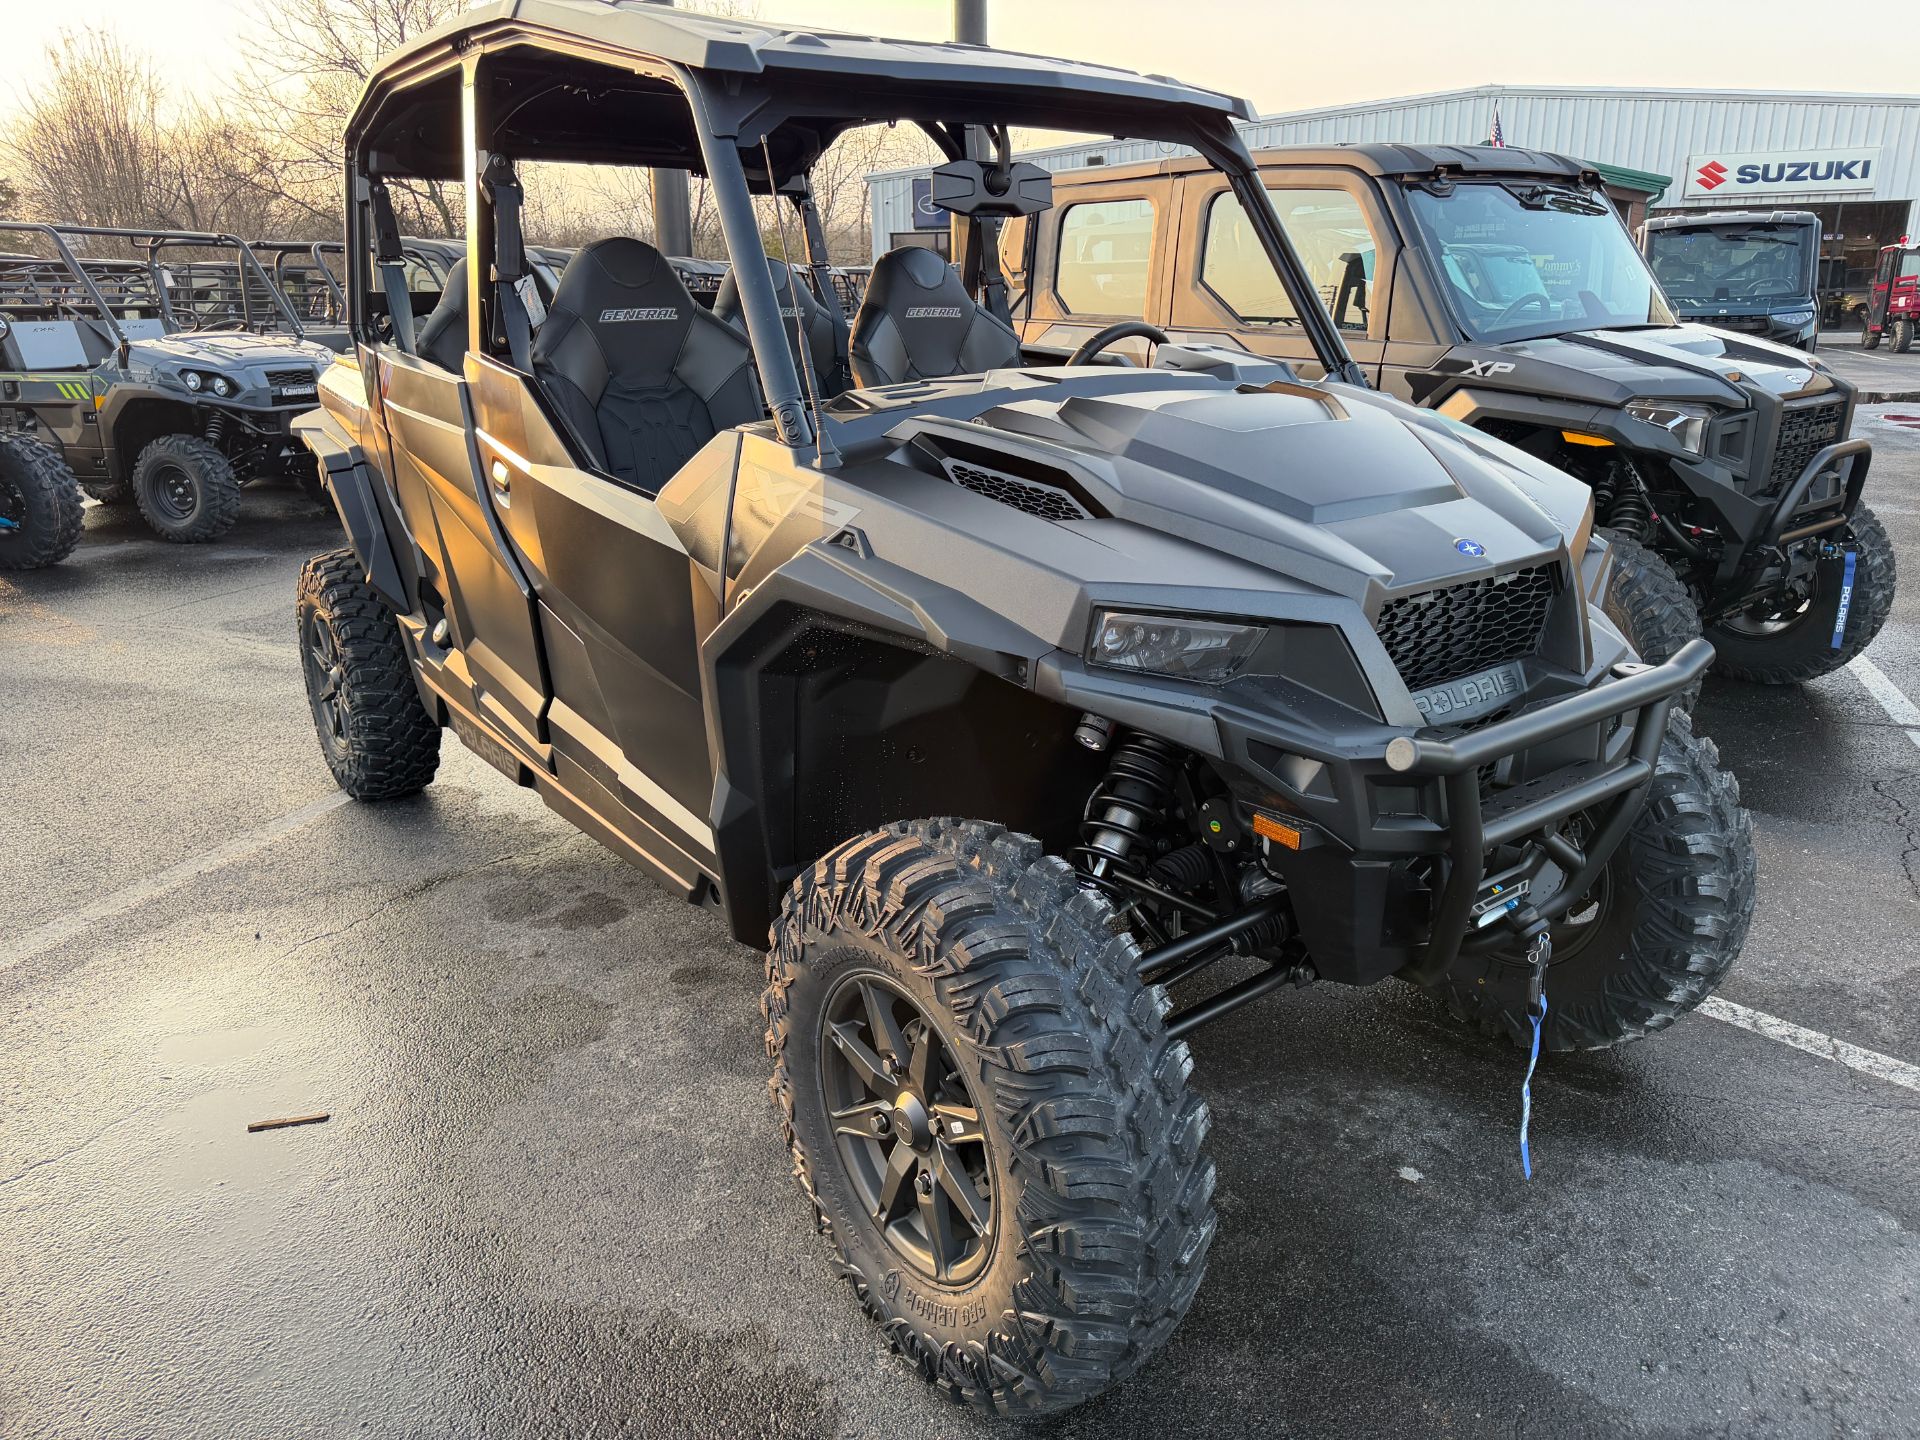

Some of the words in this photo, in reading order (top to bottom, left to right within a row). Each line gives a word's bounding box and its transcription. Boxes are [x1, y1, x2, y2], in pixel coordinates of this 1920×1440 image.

[1736, 159, 1872, 184] SUZUKI
[1531, 254, 1582, 275] Tommy's
[600, 307, 678, 322] GENERAL
[906, 307, 961, 318] GENERAL
[1459, 359, 1516, 377] XP
[281, 385, 316, 396] Kawasaki
[1780, 421, 1837, 449] POLARIS
[1835, 586, 1851, 633] POLARIS
[1414, 669, 1519, 716] POLARIS
[453, 715, 517, 778] POLARIS
